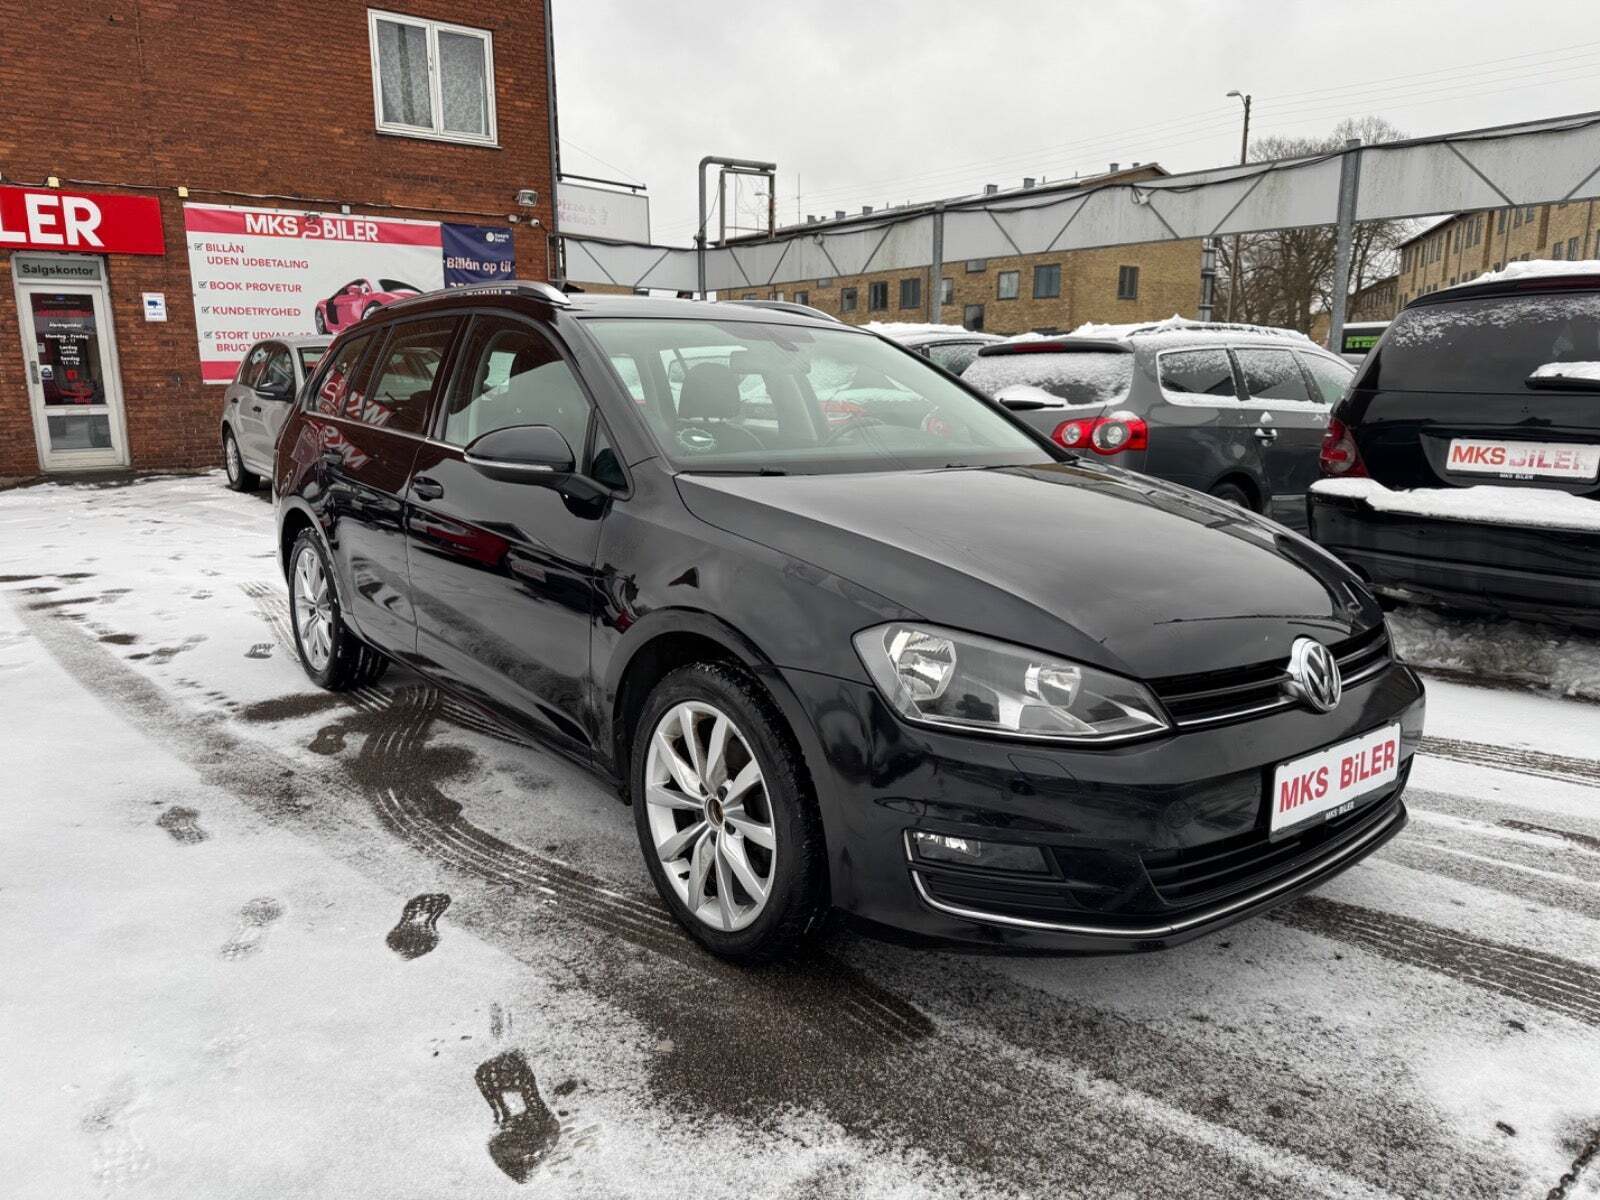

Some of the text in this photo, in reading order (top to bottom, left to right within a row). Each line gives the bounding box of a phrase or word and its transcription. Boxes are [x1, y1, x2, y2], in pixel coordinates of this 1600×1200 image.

[245, 213, 379, 242] MKS BILER
[205, 242, 245, 253] BILLÅN
[207, 256, 309, 269] UDEN UDBETALING
[446, 257, 512, 275] Billån op til
[22, 263, 94, 276] Salgskontor
[210, 281, 302, 293] BOOK PRØVETUR
[213, 306, 301, 317] KUNDETRYGHED
[215, 331, 248, 340] STORT
[1452, 445, 1506, 465] MKS
[1280, 740, 1396, 813] MKS BiLER
